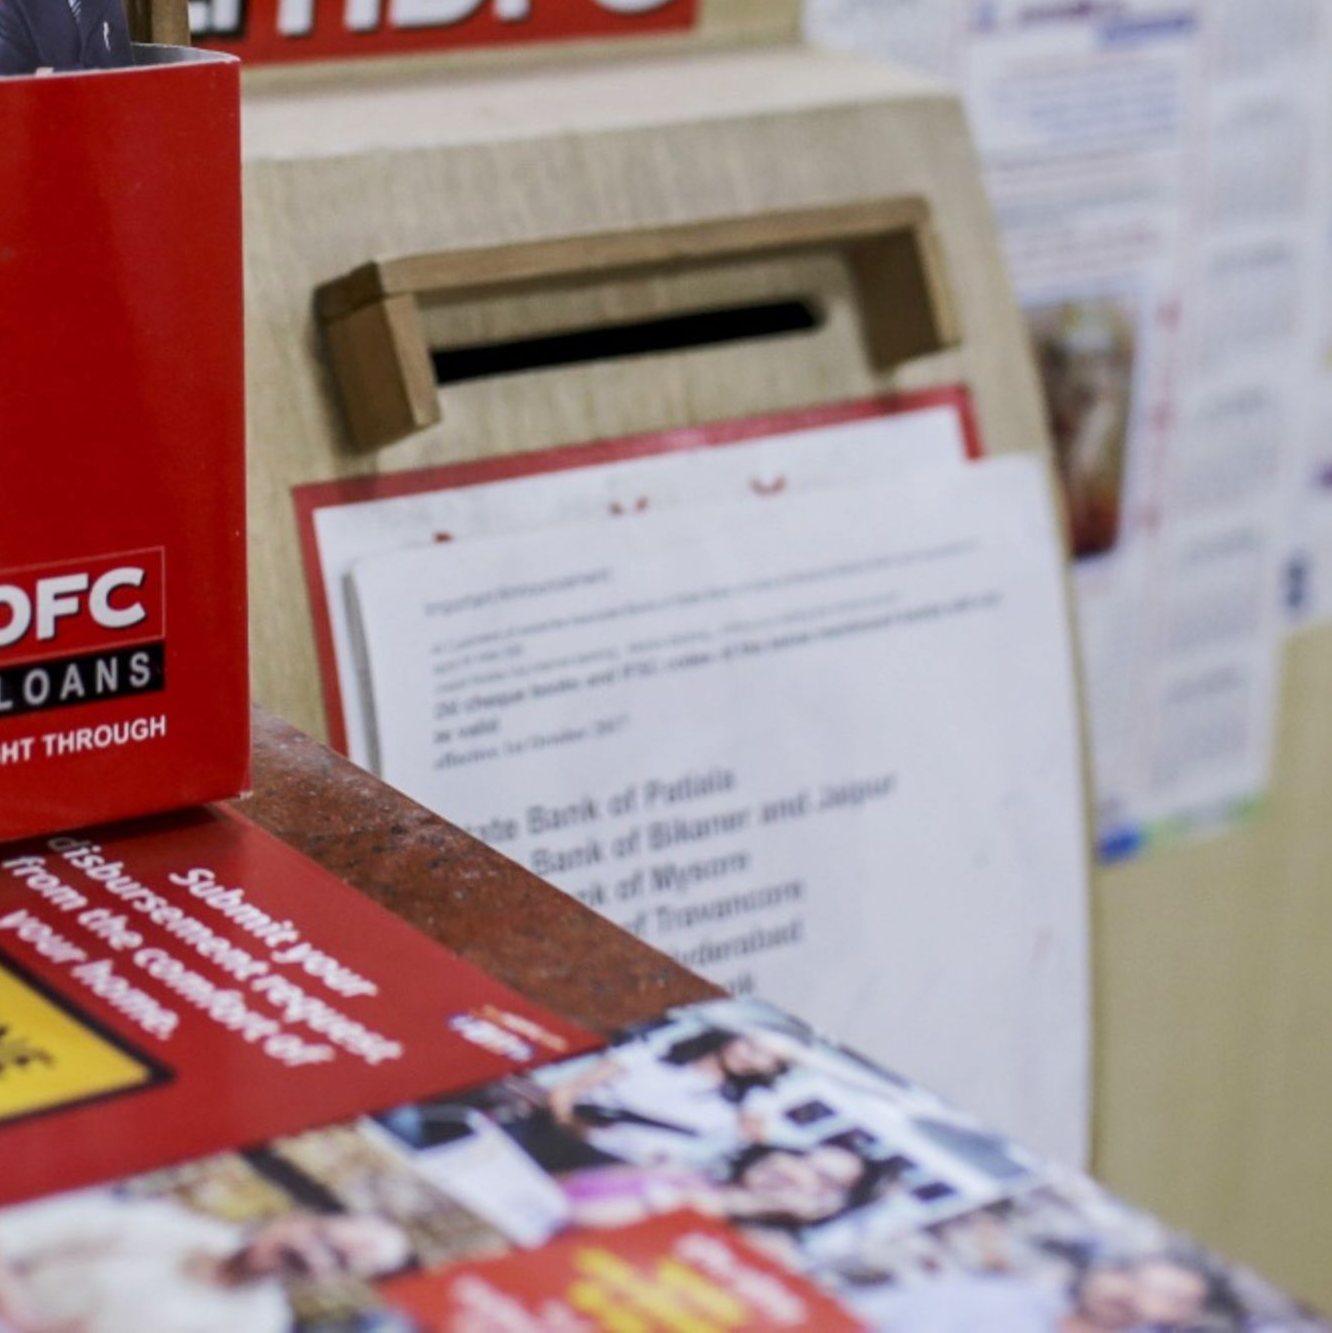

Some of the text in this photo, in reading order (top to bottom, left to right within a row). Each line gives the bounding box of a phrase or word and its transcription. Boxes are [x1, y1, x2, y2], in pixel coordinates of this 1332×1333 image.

[41, 714, 167, 758] THROUGH
[2, 854, 88, 912] from
[77, 906, 144, 951] the
[169, 866, 379, 998] Submit your
